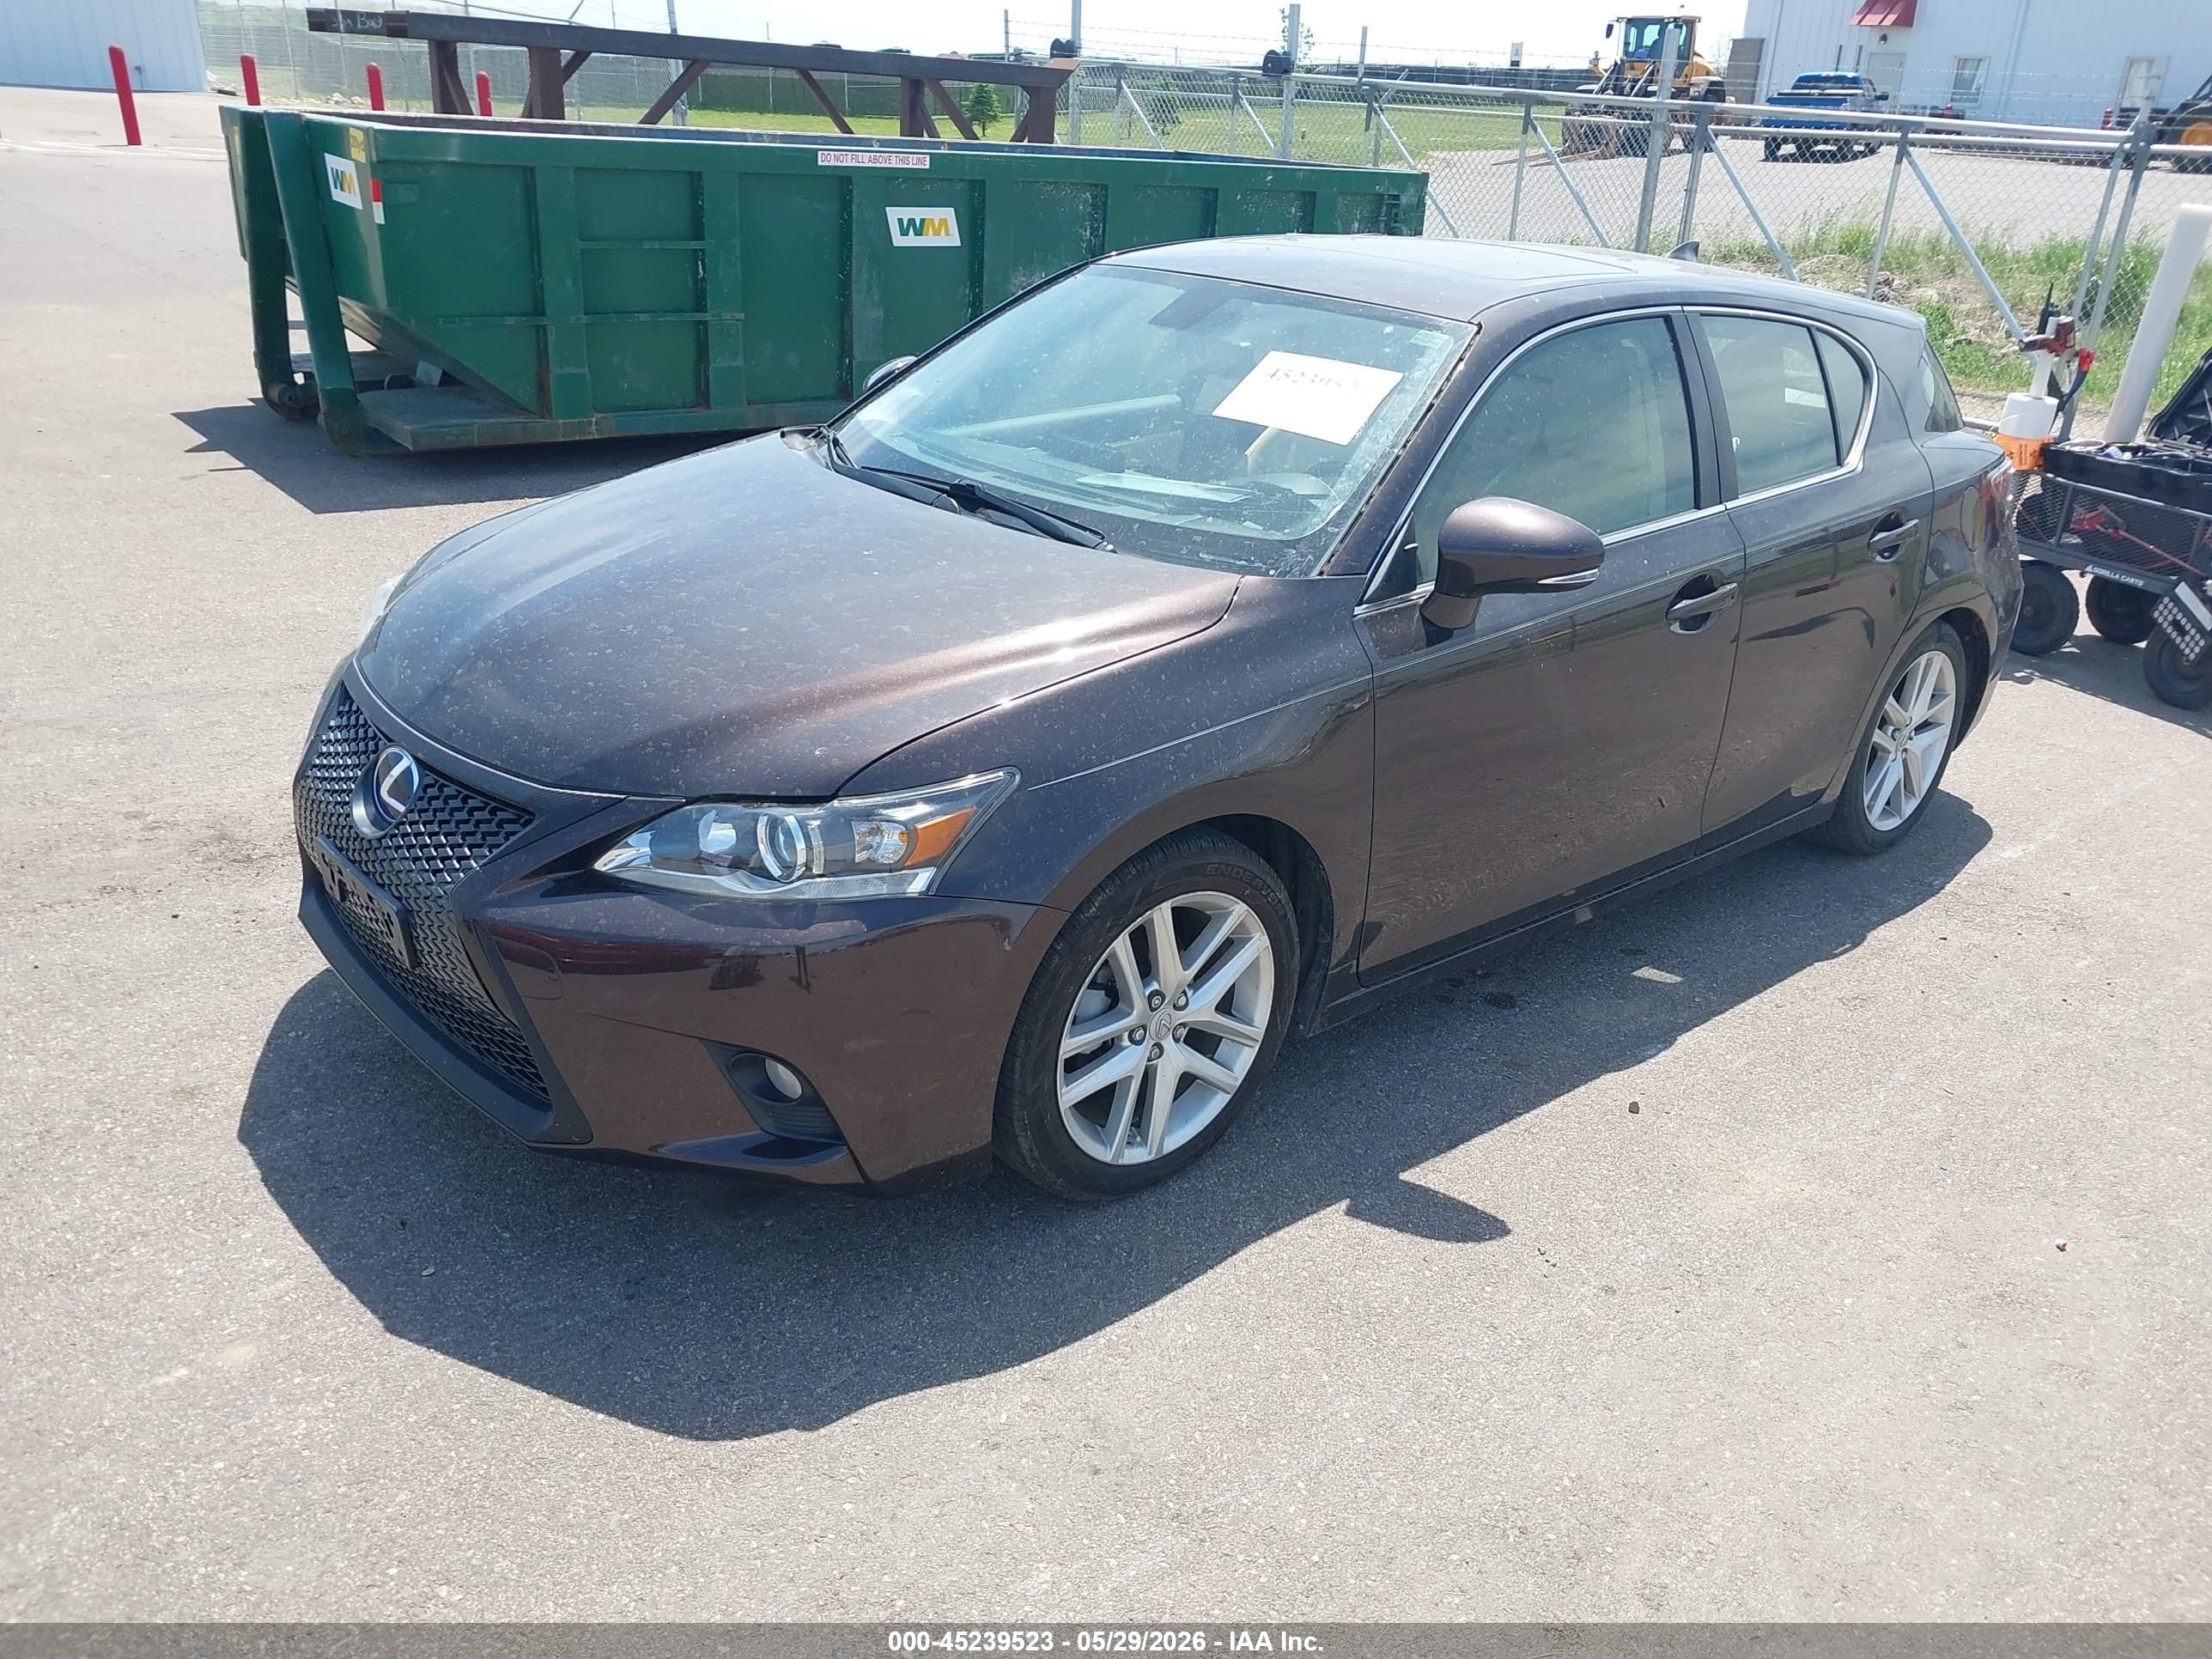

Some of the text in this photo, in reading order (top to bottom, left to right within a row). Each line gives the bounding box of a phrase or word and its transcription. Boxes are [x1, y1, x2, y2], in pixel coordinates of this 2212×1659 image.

[821, 153, 928, 167] DO NOT FILL ABOVE THIS LINE
[331, 167, 356, 197] WM
[896, 217, 949, 236] WM
